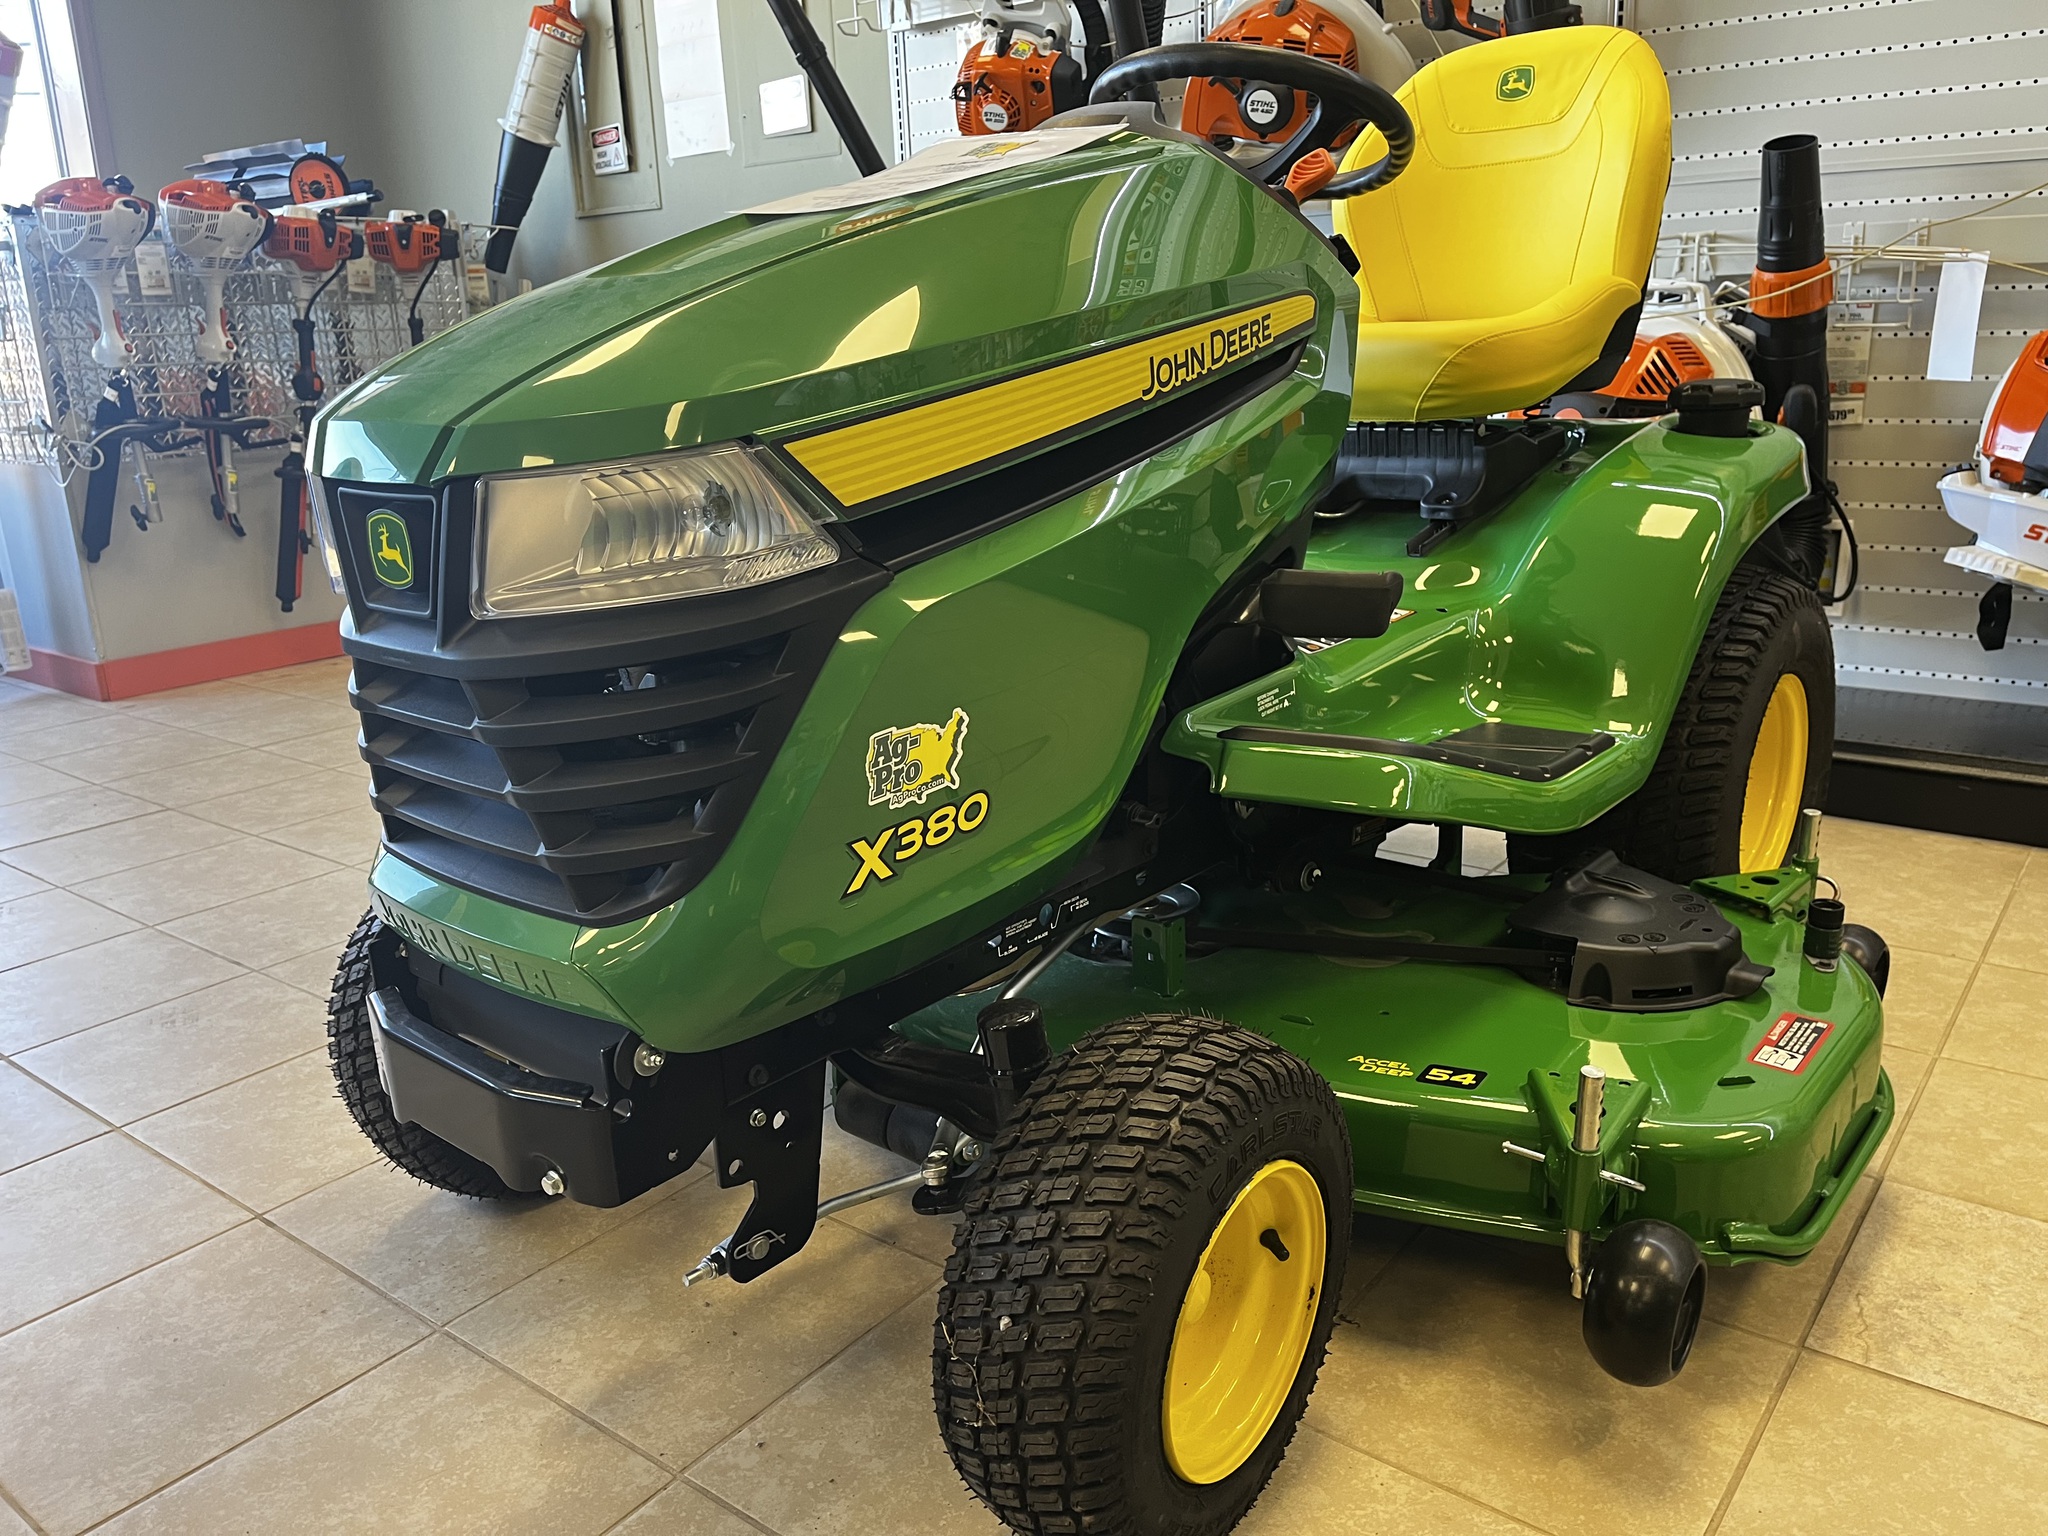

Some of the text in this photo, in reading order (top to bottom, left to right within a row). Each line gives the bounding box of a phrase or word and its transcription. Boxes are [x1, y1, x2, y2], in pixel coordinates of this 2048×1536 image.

[555, 73, 572, 120] STIHL
[983, 110, 1007, 119] STIHL
[1249, 100, 1275, 109] STIHL
[1141, 312, 1273, 398] JOHN DEERE
[872, 732, 921, 771] Ag-
[871, 760, 922, 800] Pro
[891, 776, 945, 806] AgProCo.com
[841, 791, 989, 898] X380
[1425, 1067, 1477, 1086] 54
[1207, 1110, 1323, 1206] CARLSTAR
